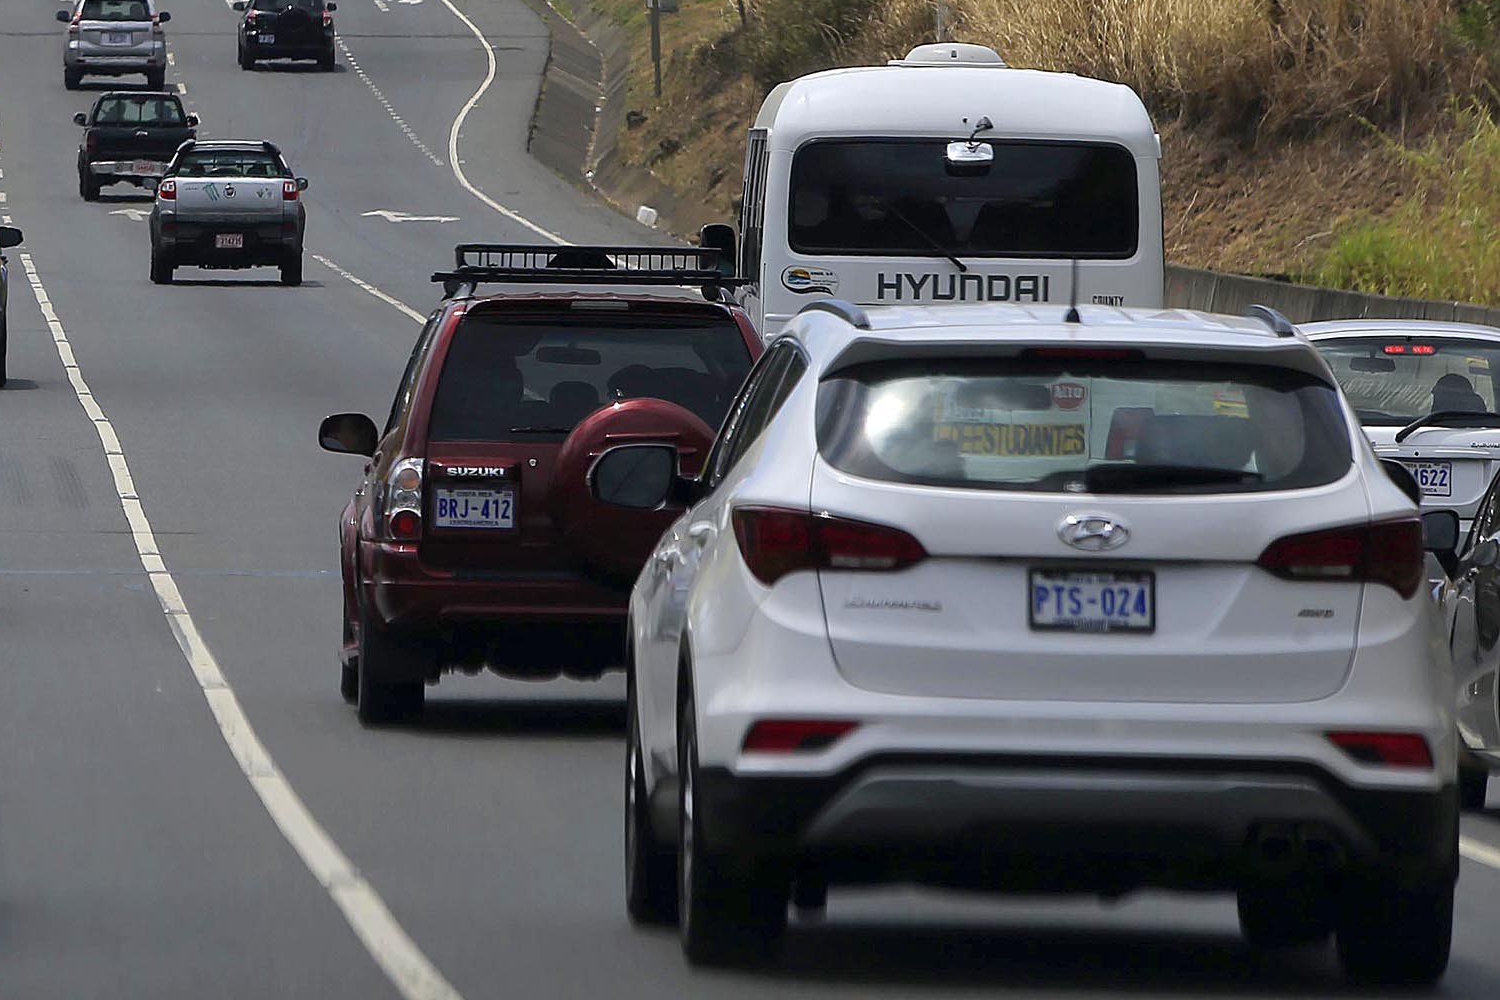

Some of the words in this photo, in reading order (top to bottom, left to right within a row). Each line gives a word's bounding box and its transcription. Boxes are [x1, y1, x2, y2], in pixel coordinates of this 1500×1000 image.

[877, 272, 1049, 302] HYUNDAI
[1092, 295, 1124, 307] COUNTY
[1053, 385, 1083, 399] ALTO
[446, 467, 505, 477] SUZUKI
[439, 498, 510, 520] BRJ-412
[1034, 586, 1147, 616] PTS-024
